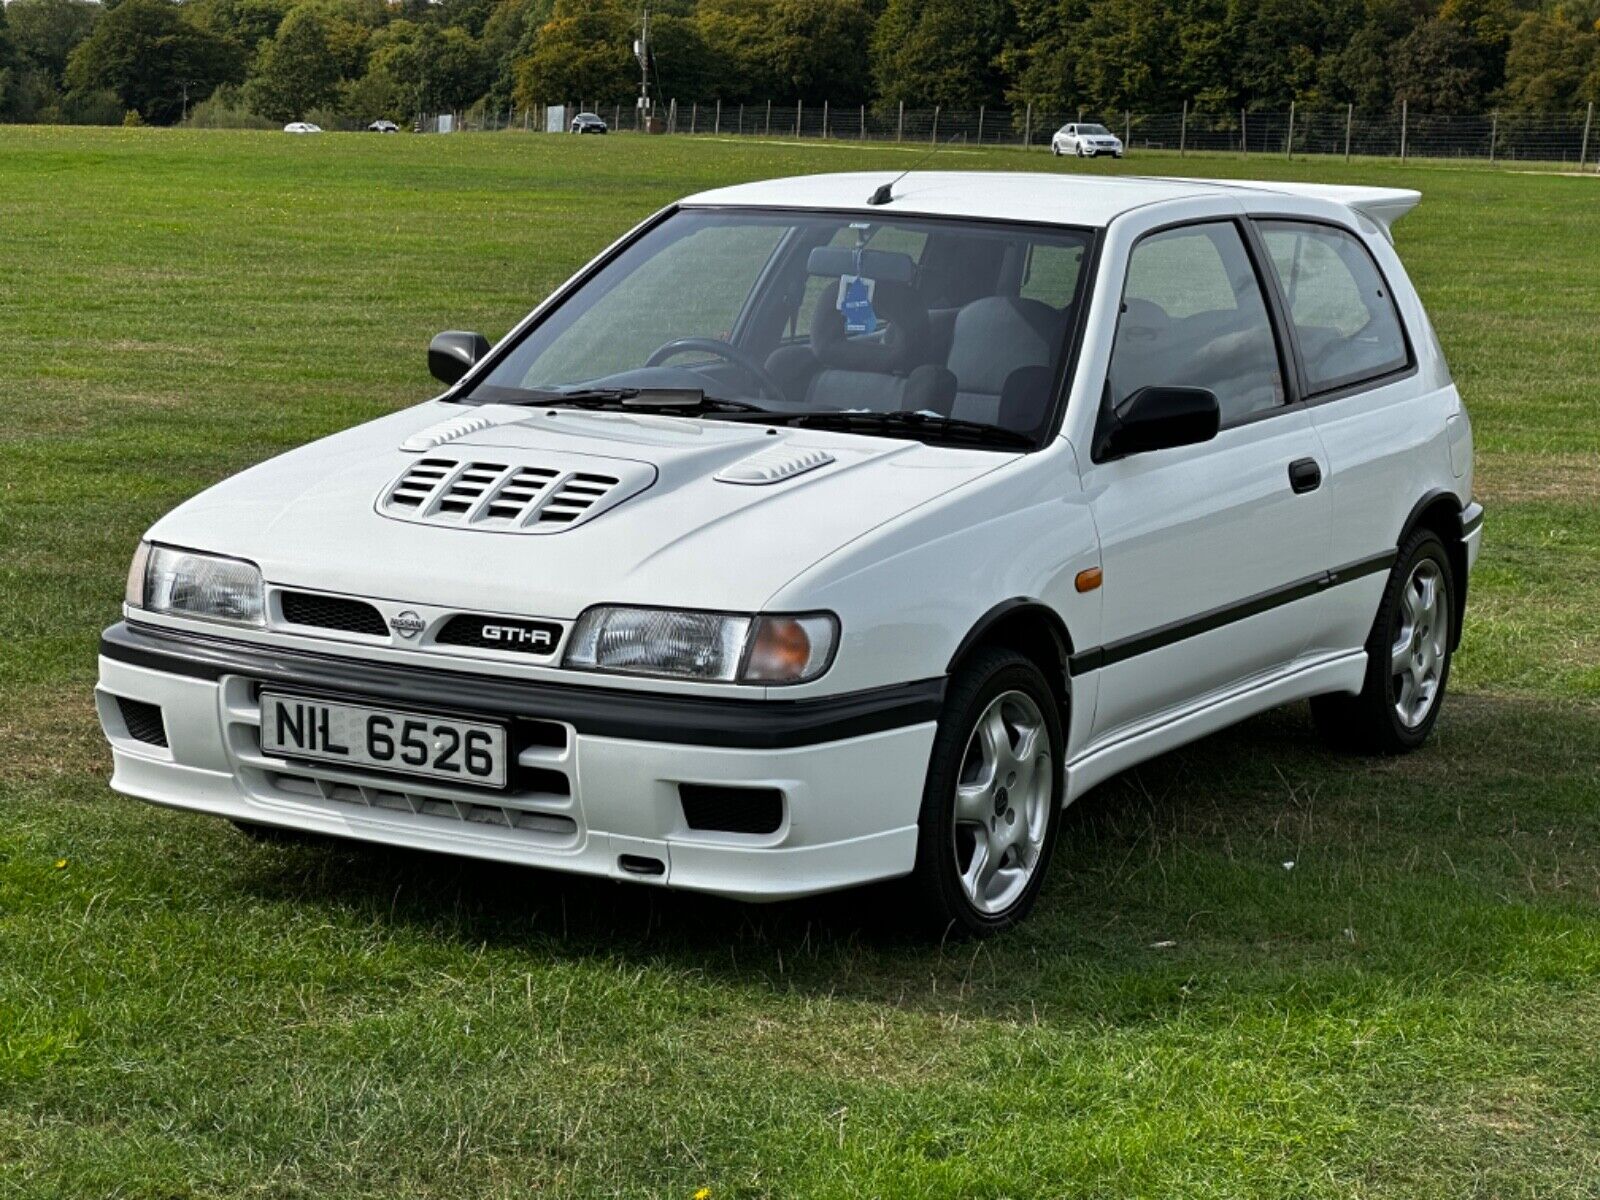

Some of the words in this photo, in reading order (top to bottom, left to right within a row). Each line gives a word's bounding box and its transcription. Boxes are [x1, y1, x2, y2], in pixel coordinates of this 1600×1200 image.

[390, 618, 425, 630] NISSAN
[482, 625, 551, 645] GTI-R
[276, 701, 349, 755] NIL
[366, 715, 493, 777] 6526
